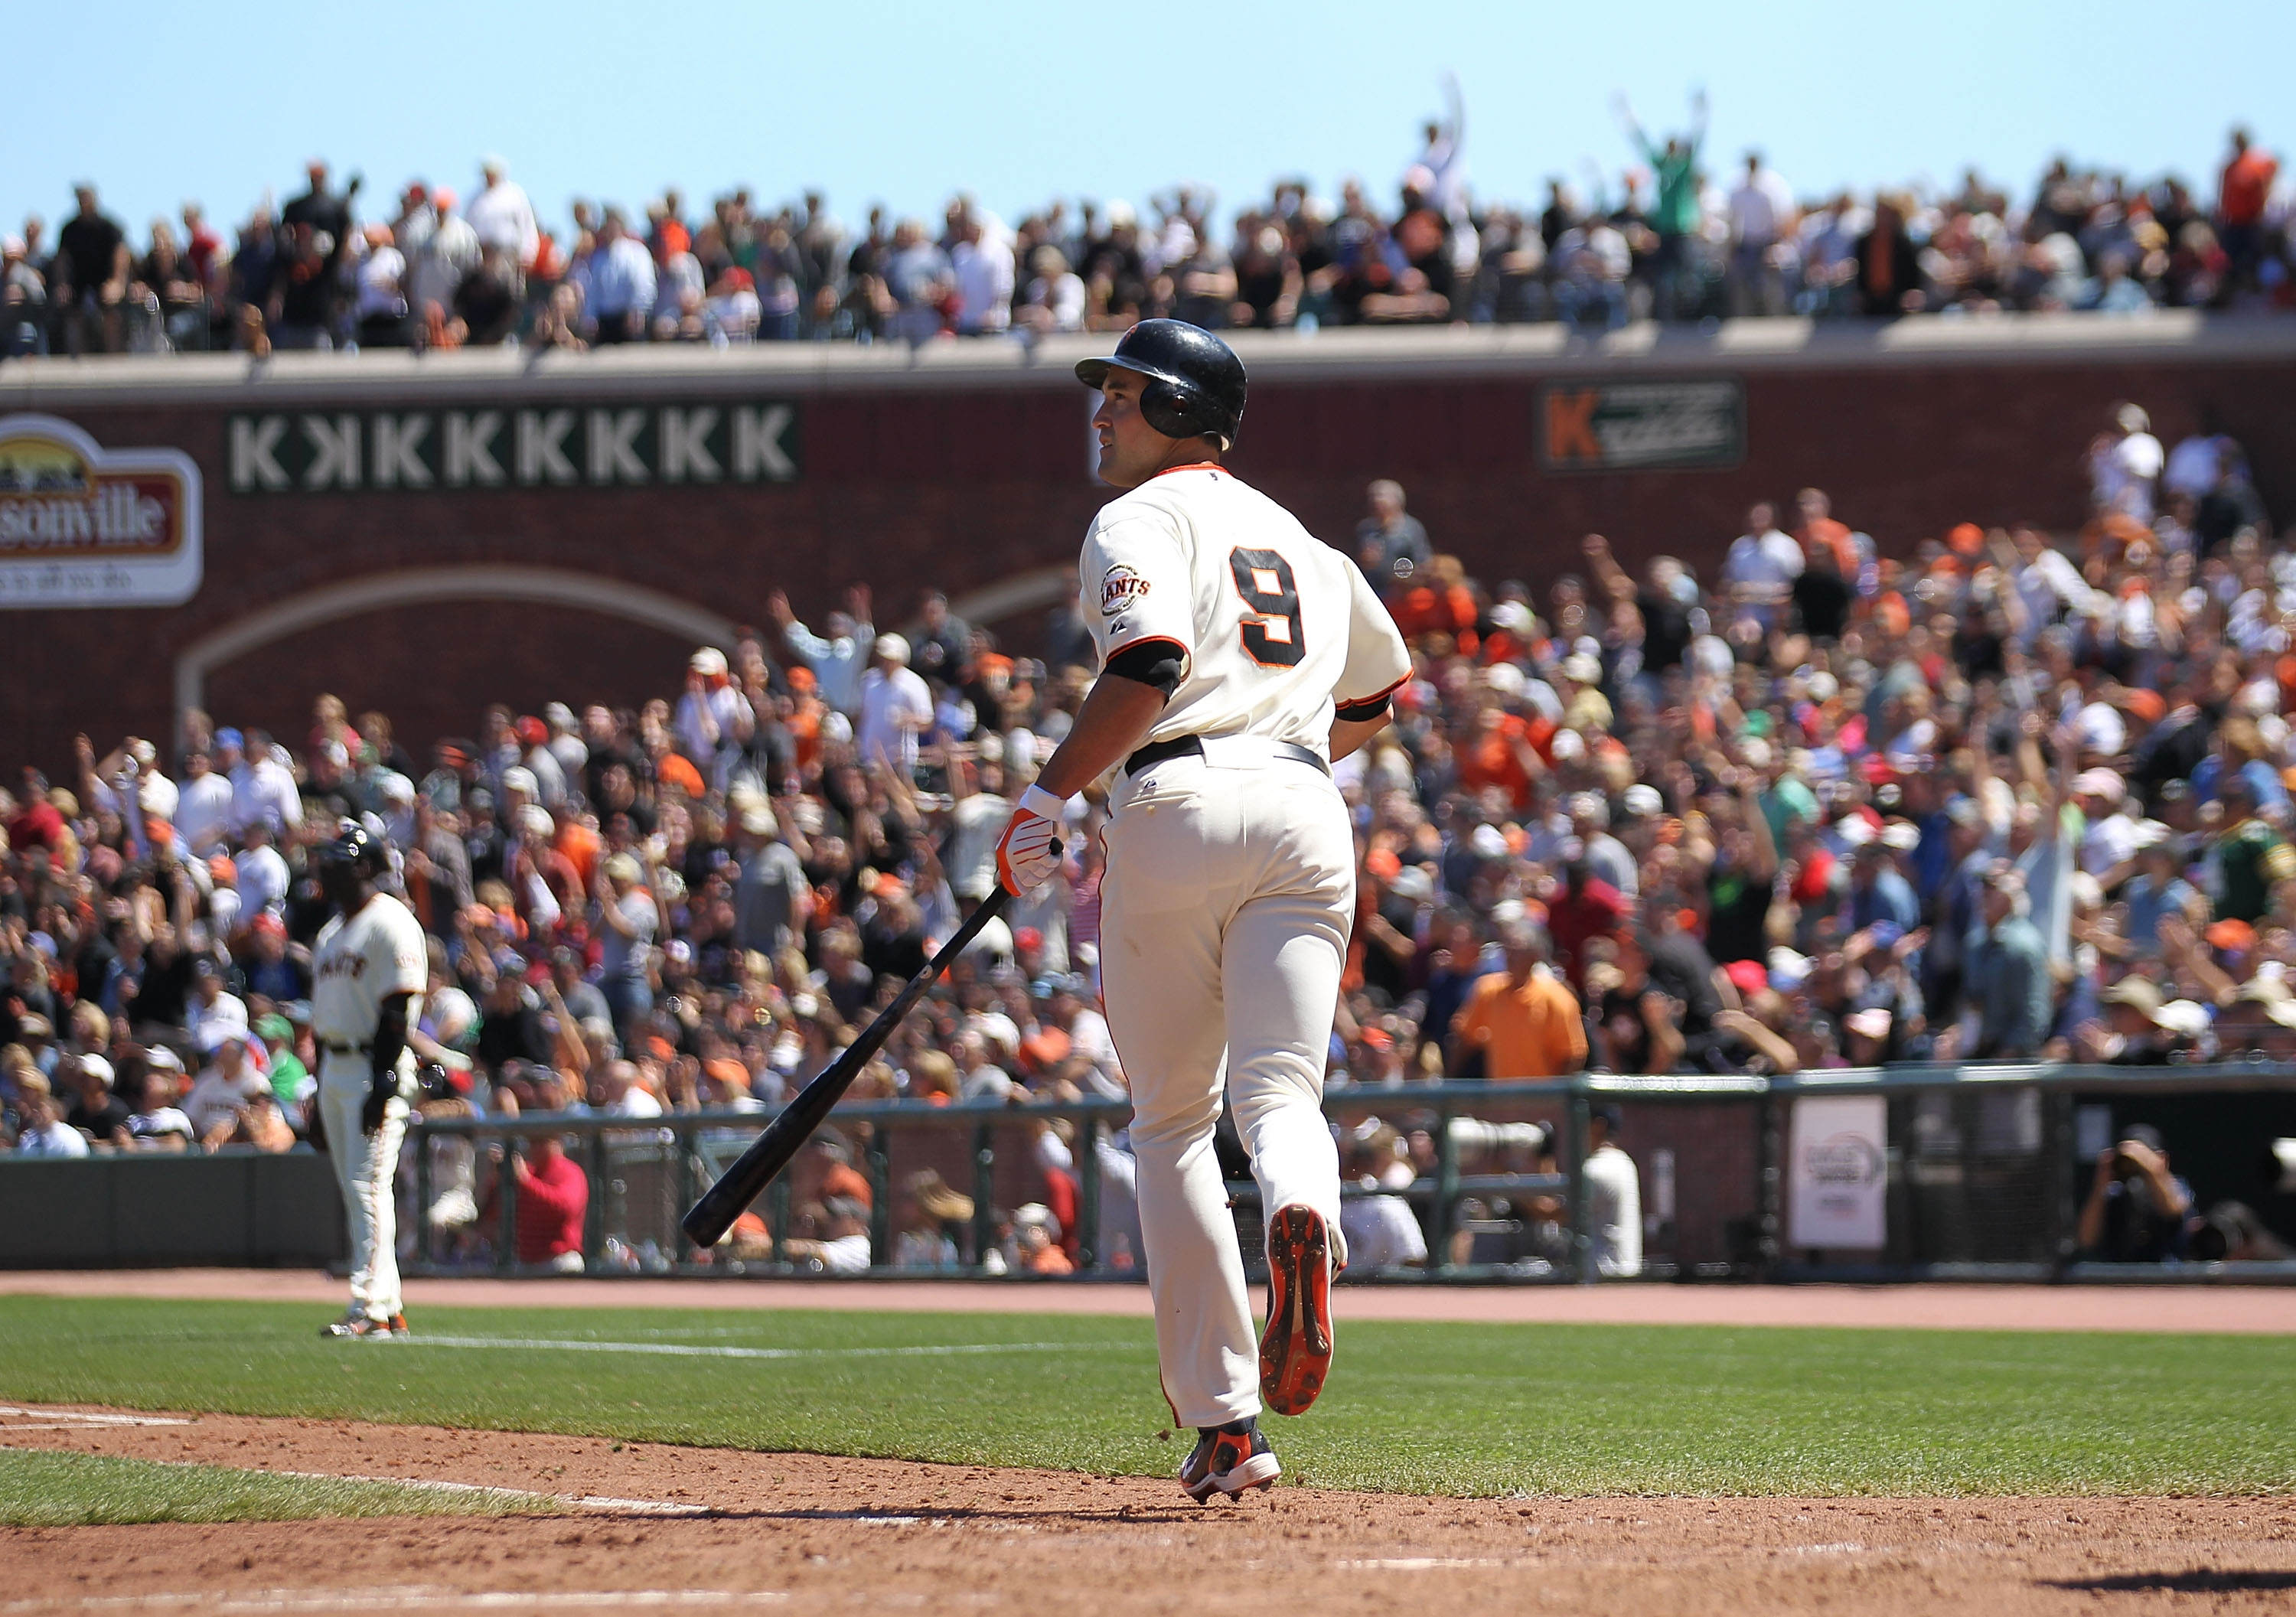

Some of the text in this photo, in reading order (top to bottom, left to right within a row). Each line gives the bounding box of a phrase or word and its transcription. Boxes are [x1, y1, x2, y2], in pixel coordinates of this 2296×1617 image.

[1547, 389, 1601, 459] K
[1101, 577, 1151, 608] IANTS
[1229, 545, 1306, 670] 9
